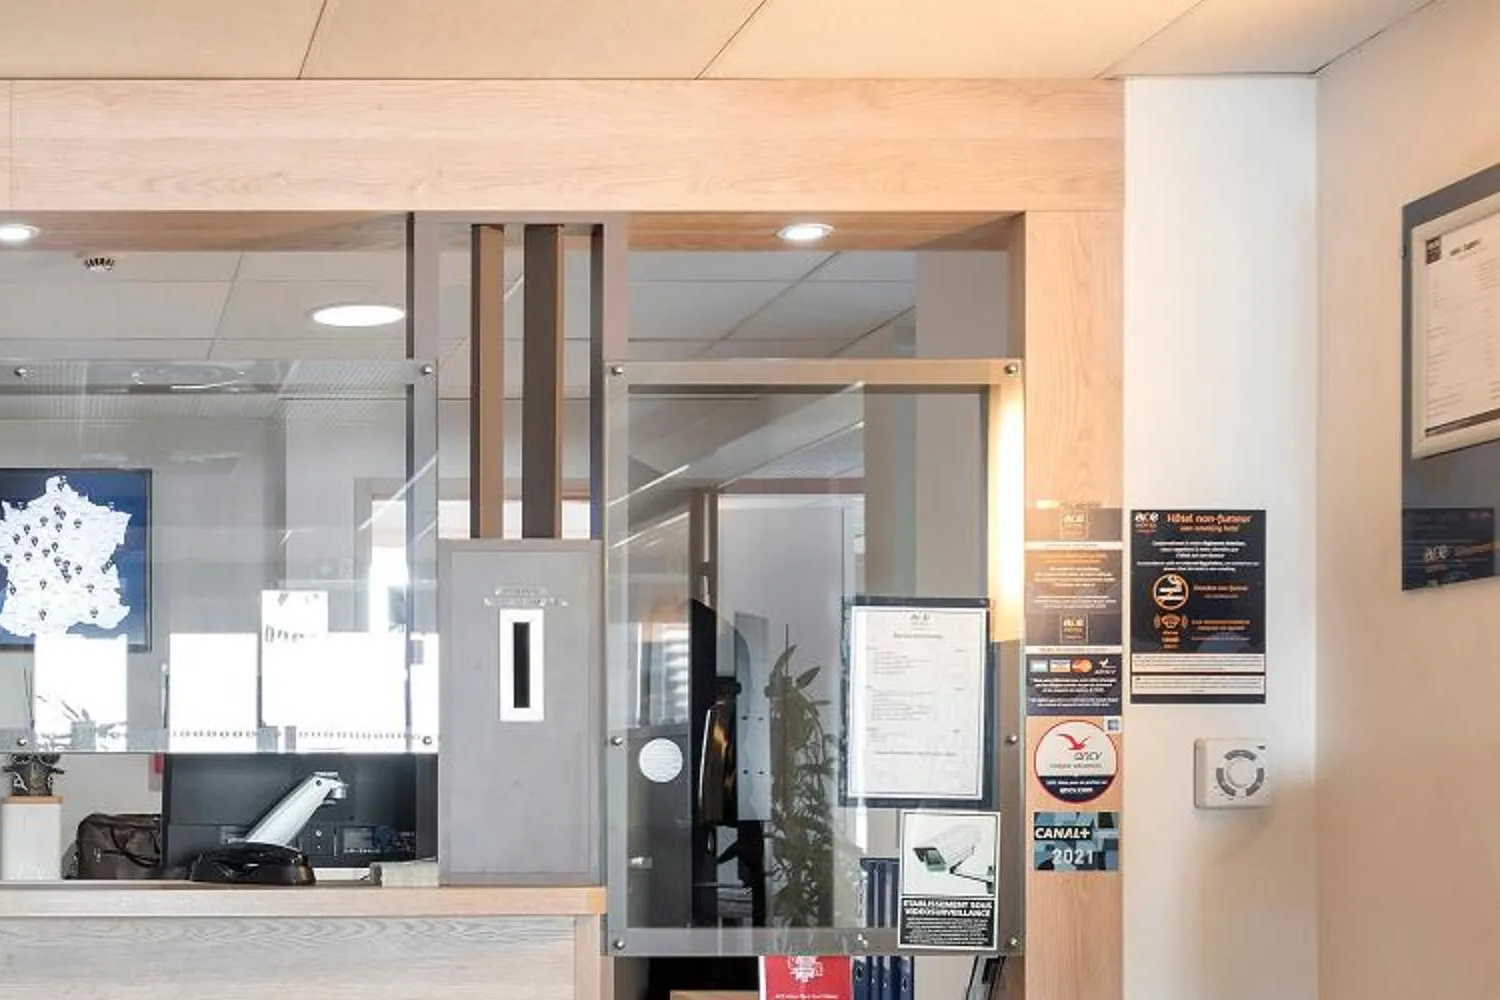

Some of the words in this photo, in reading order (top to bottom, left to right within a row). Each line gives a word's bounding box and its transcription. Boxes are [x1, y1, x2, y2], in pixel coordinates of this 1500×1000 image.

[1135, 512, 1159, 522] ace
[1035, 828, 1091, 839] CANAL+
[1052, 849, 1095, 865] 2021
